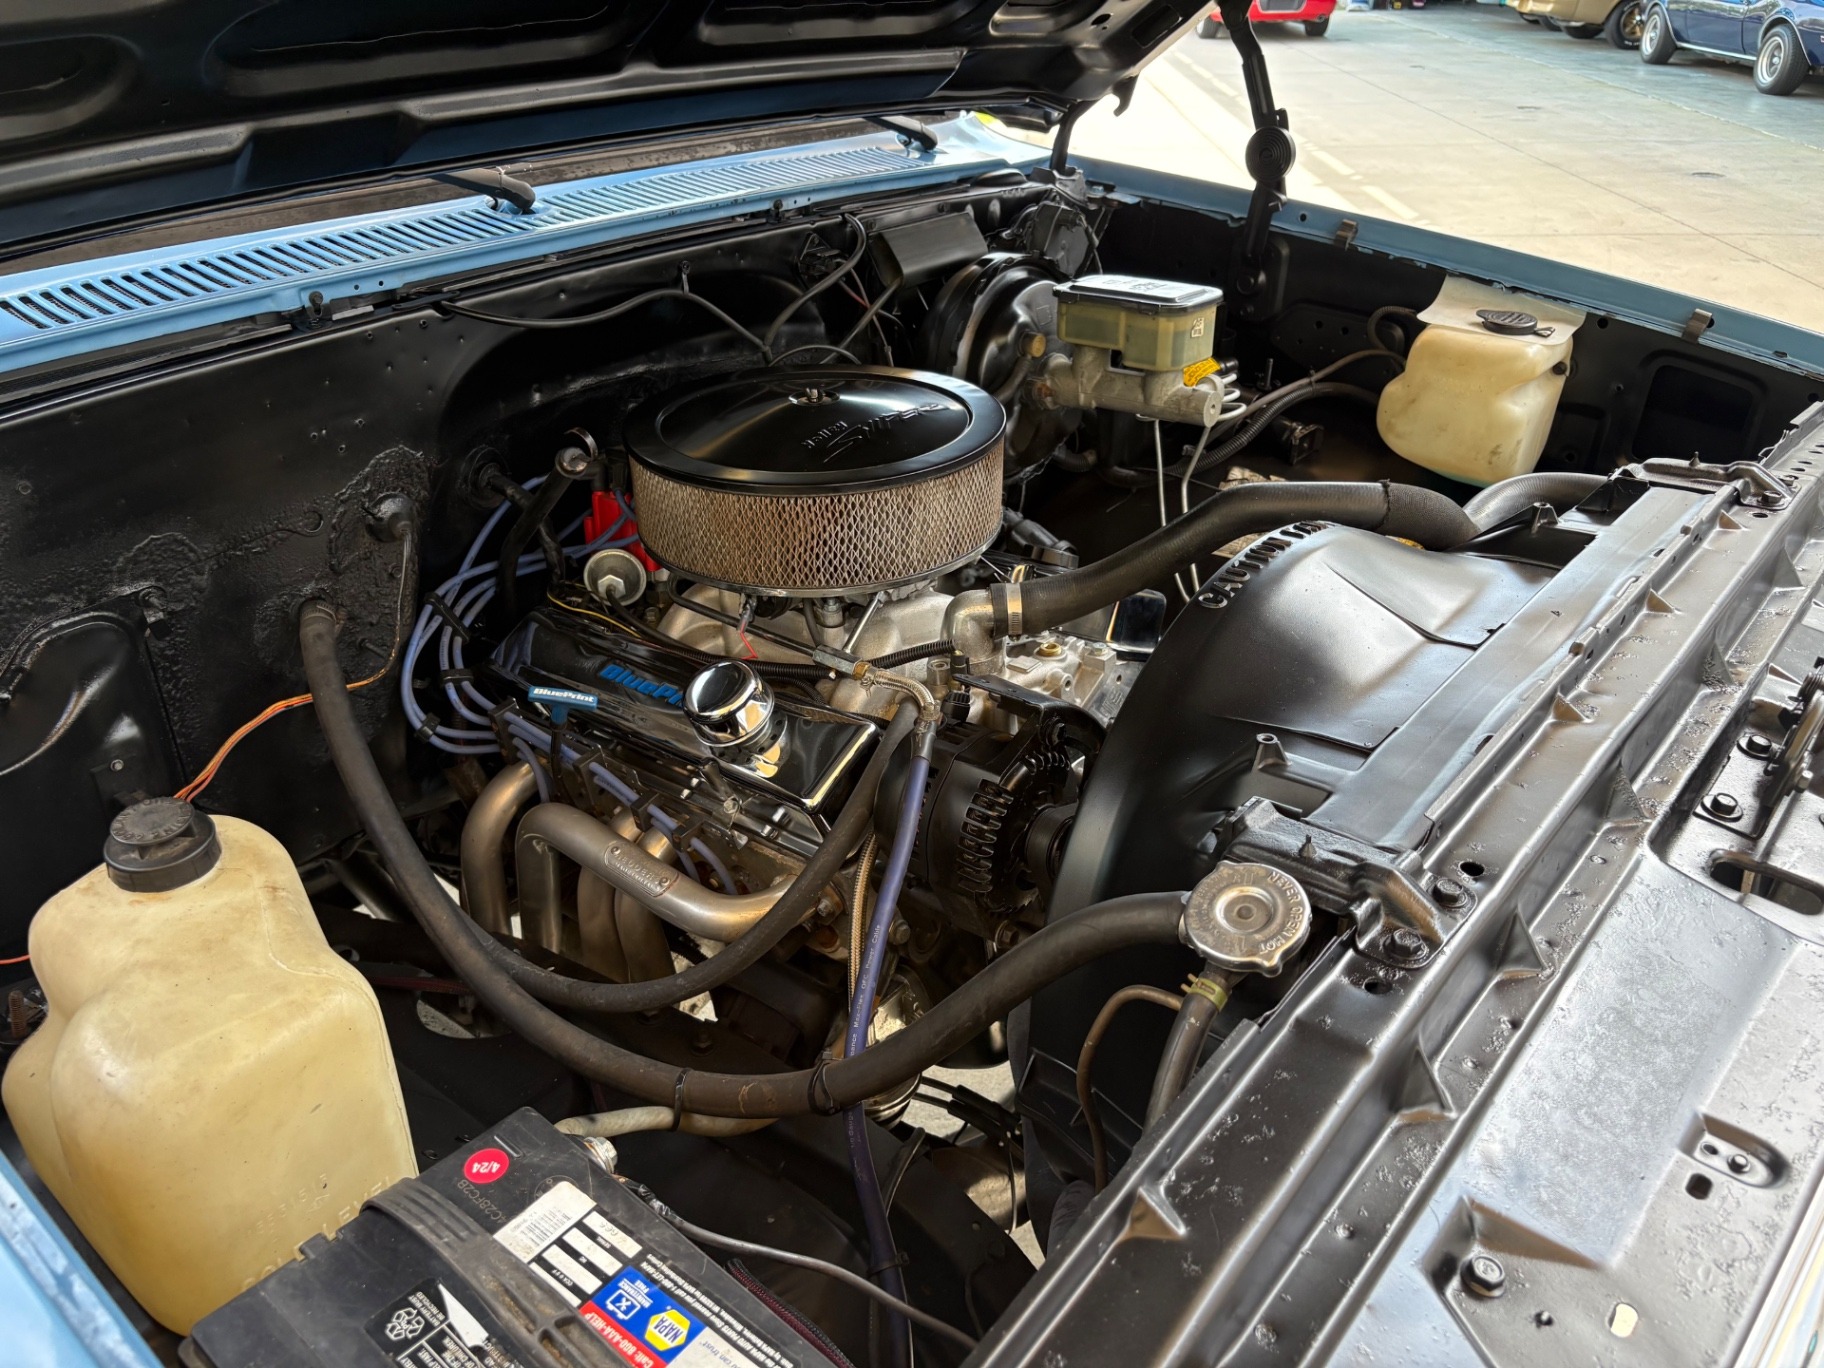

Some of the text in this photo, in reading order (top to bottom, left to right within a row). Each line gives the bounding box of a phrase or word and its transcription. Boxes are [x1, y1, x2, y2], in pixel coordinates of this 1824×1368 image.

[1199, 537, 1291, 609] CAUTION
[533, 687, 595, 703] BluePrint
[1260, 871, 1303, 954] NEVER OPEN HOT
[471, 1159, 500, 1174] 4/24
[618, 1280, 650, 1308] MAINTENANCE
[634, 1279, 649, 1293] FREE
[682, 1281, 696, 1294] NAPA
[408, 1293, 439, 1325] BATTERY MUST
[416, 1291, 445, 1320] BE RECYCLED
[654, 1316, 682, 1343] NAPA
[708, 1314, 724, 1329] Store
[585, 1309, 653, 1368] Call: 800-AAA-HELP
[721, 1324, 739, 1341] PARTS
[736, 1335, 753, 1351] AUTO
[760, 1341, 776, 1357] NAPA
[749, 1345, 766, 1362] NAPA
